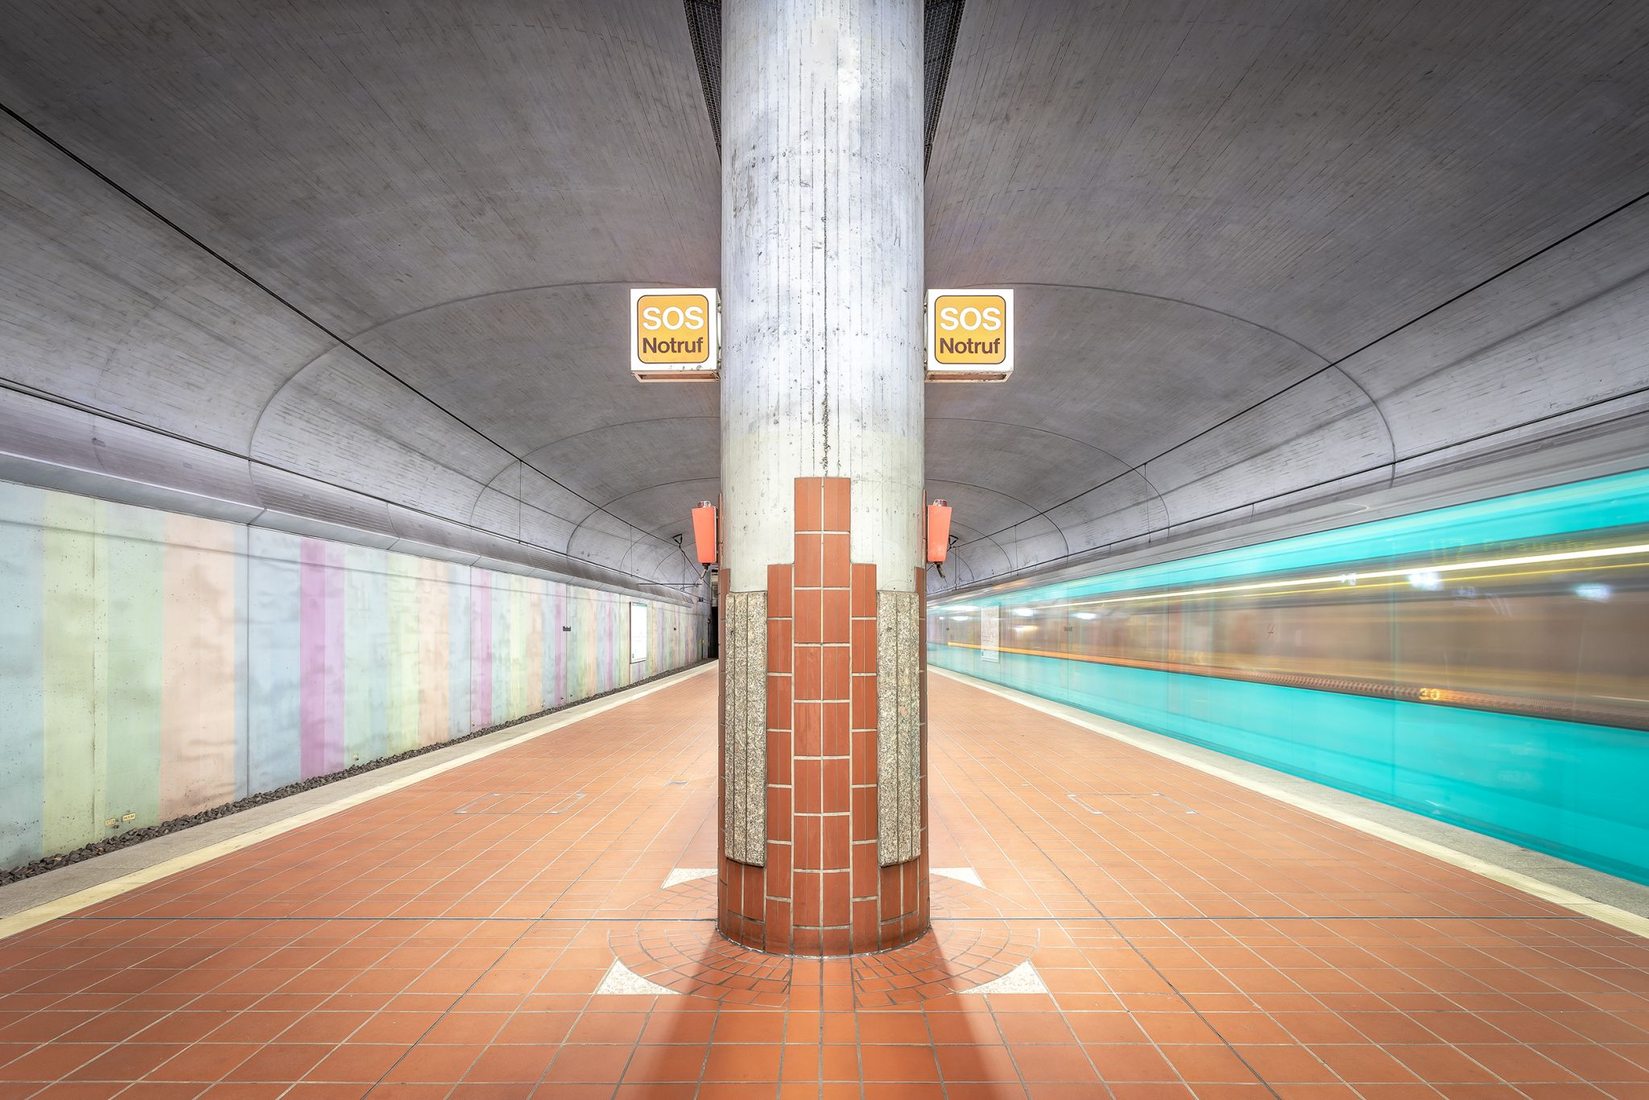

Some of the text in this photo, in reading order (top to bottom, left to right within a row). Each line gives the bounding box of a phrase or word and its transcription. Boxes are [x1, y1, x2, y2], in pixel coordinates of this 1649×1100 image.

[642, 306, 704, 331] SOS
[940, 306, 1002, 331] SOS
[642, 337, 704, 354] Notruf
[939, 337, 1001, 354] Notruf
